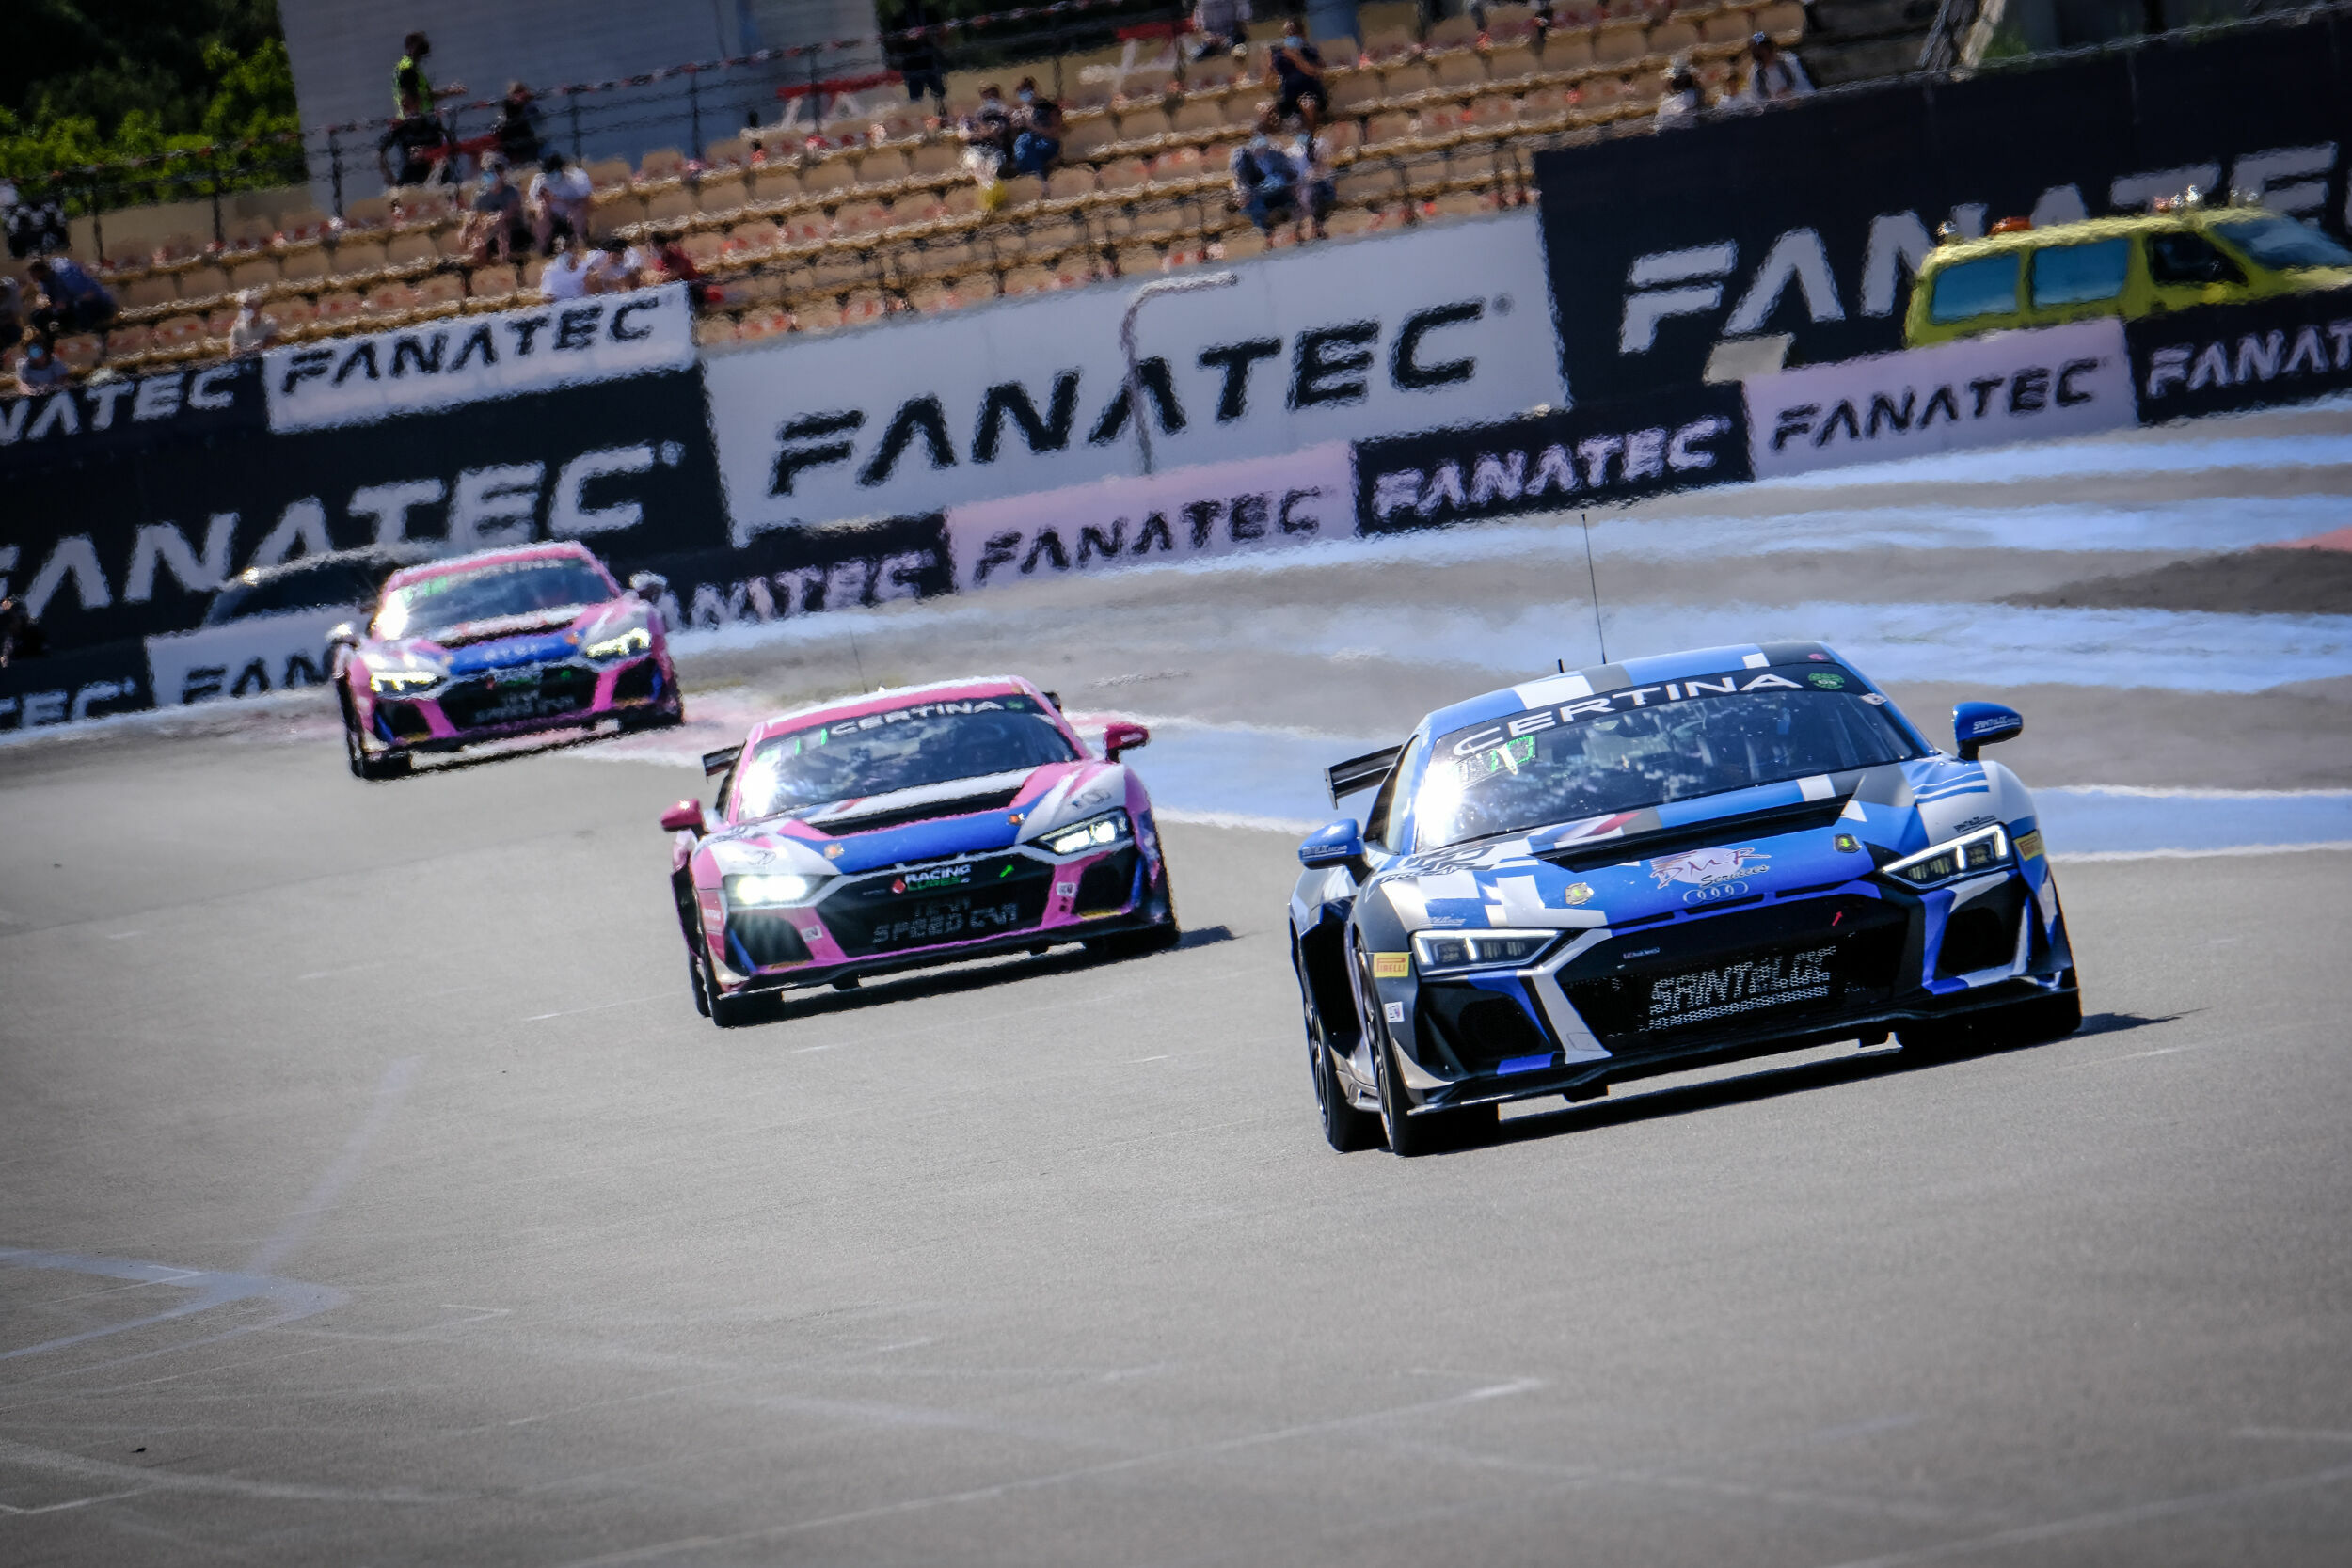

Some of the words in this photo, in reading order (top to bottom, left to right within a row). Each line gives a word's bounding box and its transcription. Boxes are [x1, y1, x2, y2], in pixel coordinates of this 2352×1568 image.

[284, 295, 662, 395] FANATEC
[767, 295, 1487, 497] FANATEC
[1768, 355, 2104, 455] FANATEC
[1372, 414, 1733, 521] FANATEC
[971, 486, 1320, 585] FANATEC
[830, 700, 1005, 736] CERTINA
[1453, 673, 1804, 756] CERTINA
[905, 864, 972, 884] RACING
[1699, 863, 1770, 887] Services
[1377, 958, 1406, 973] PIRELLI
